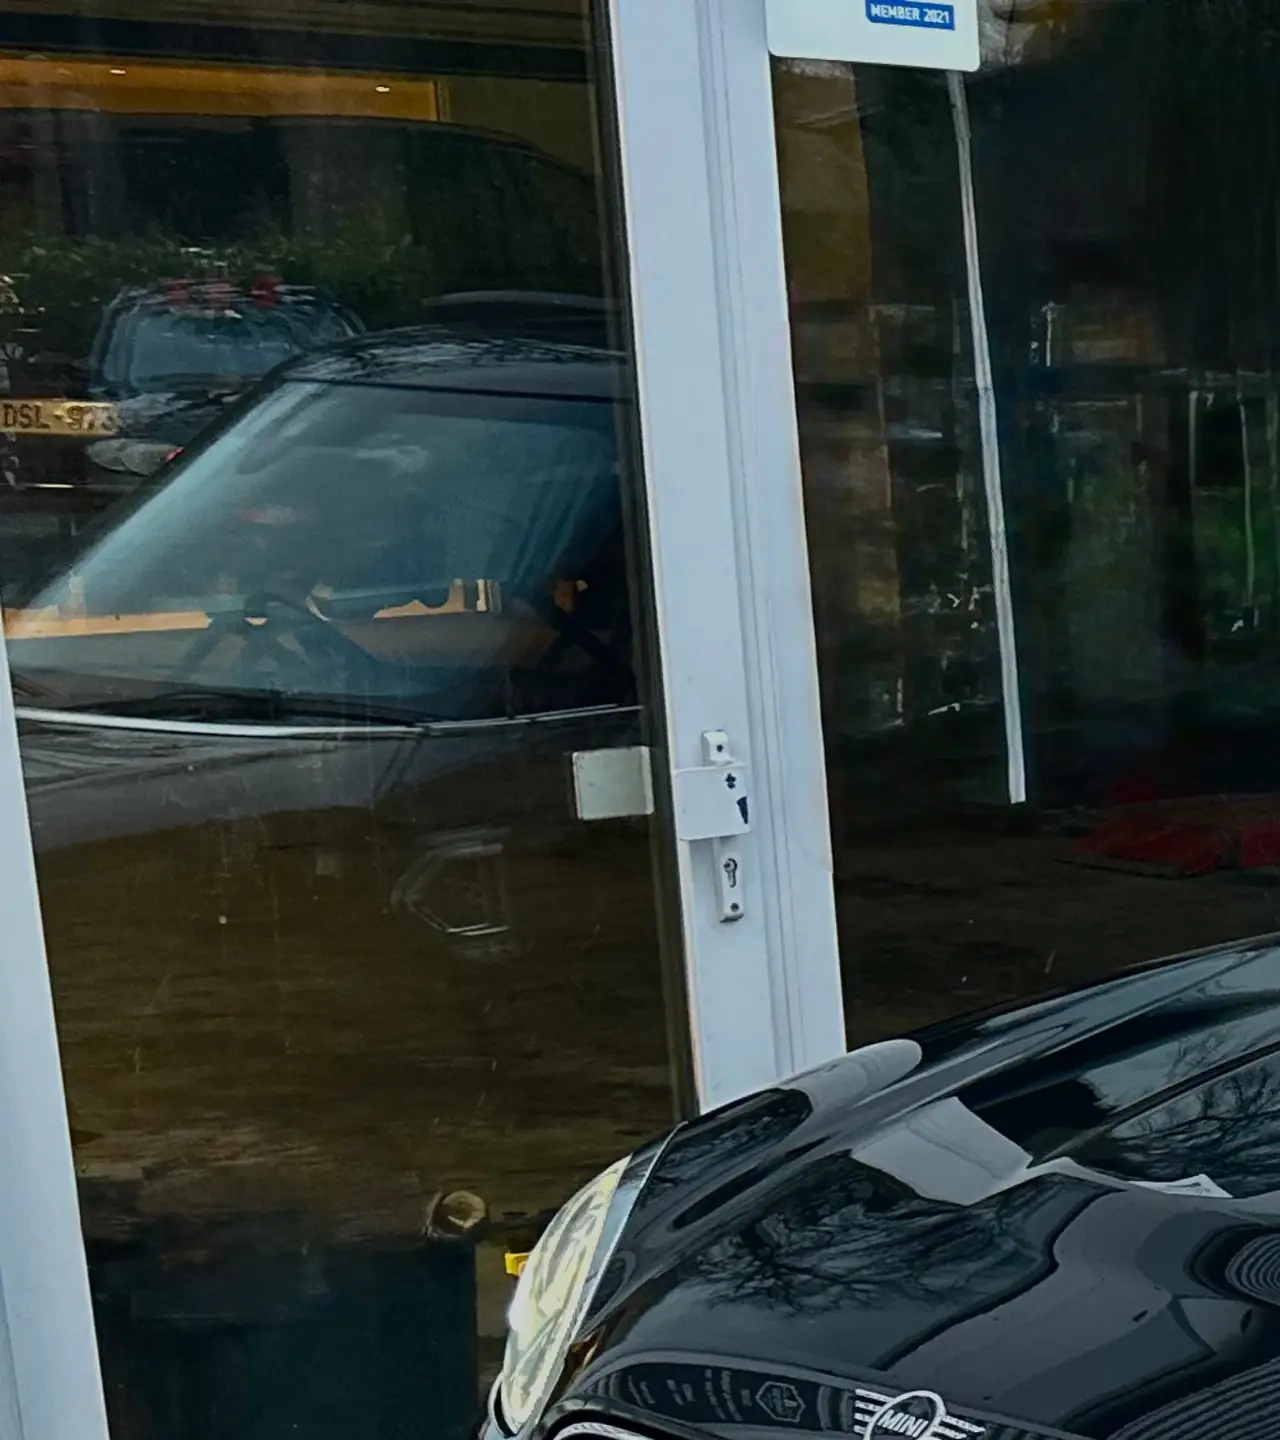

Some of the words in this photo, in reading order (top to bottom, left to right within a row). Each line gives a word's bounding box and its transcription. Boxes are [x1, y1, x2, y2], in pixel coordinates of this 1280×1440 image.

[870, 3, 920, 21] MEMBER
[923, 8, 950, 24] 2021
[877, 1409, 930, 1438] MINI
